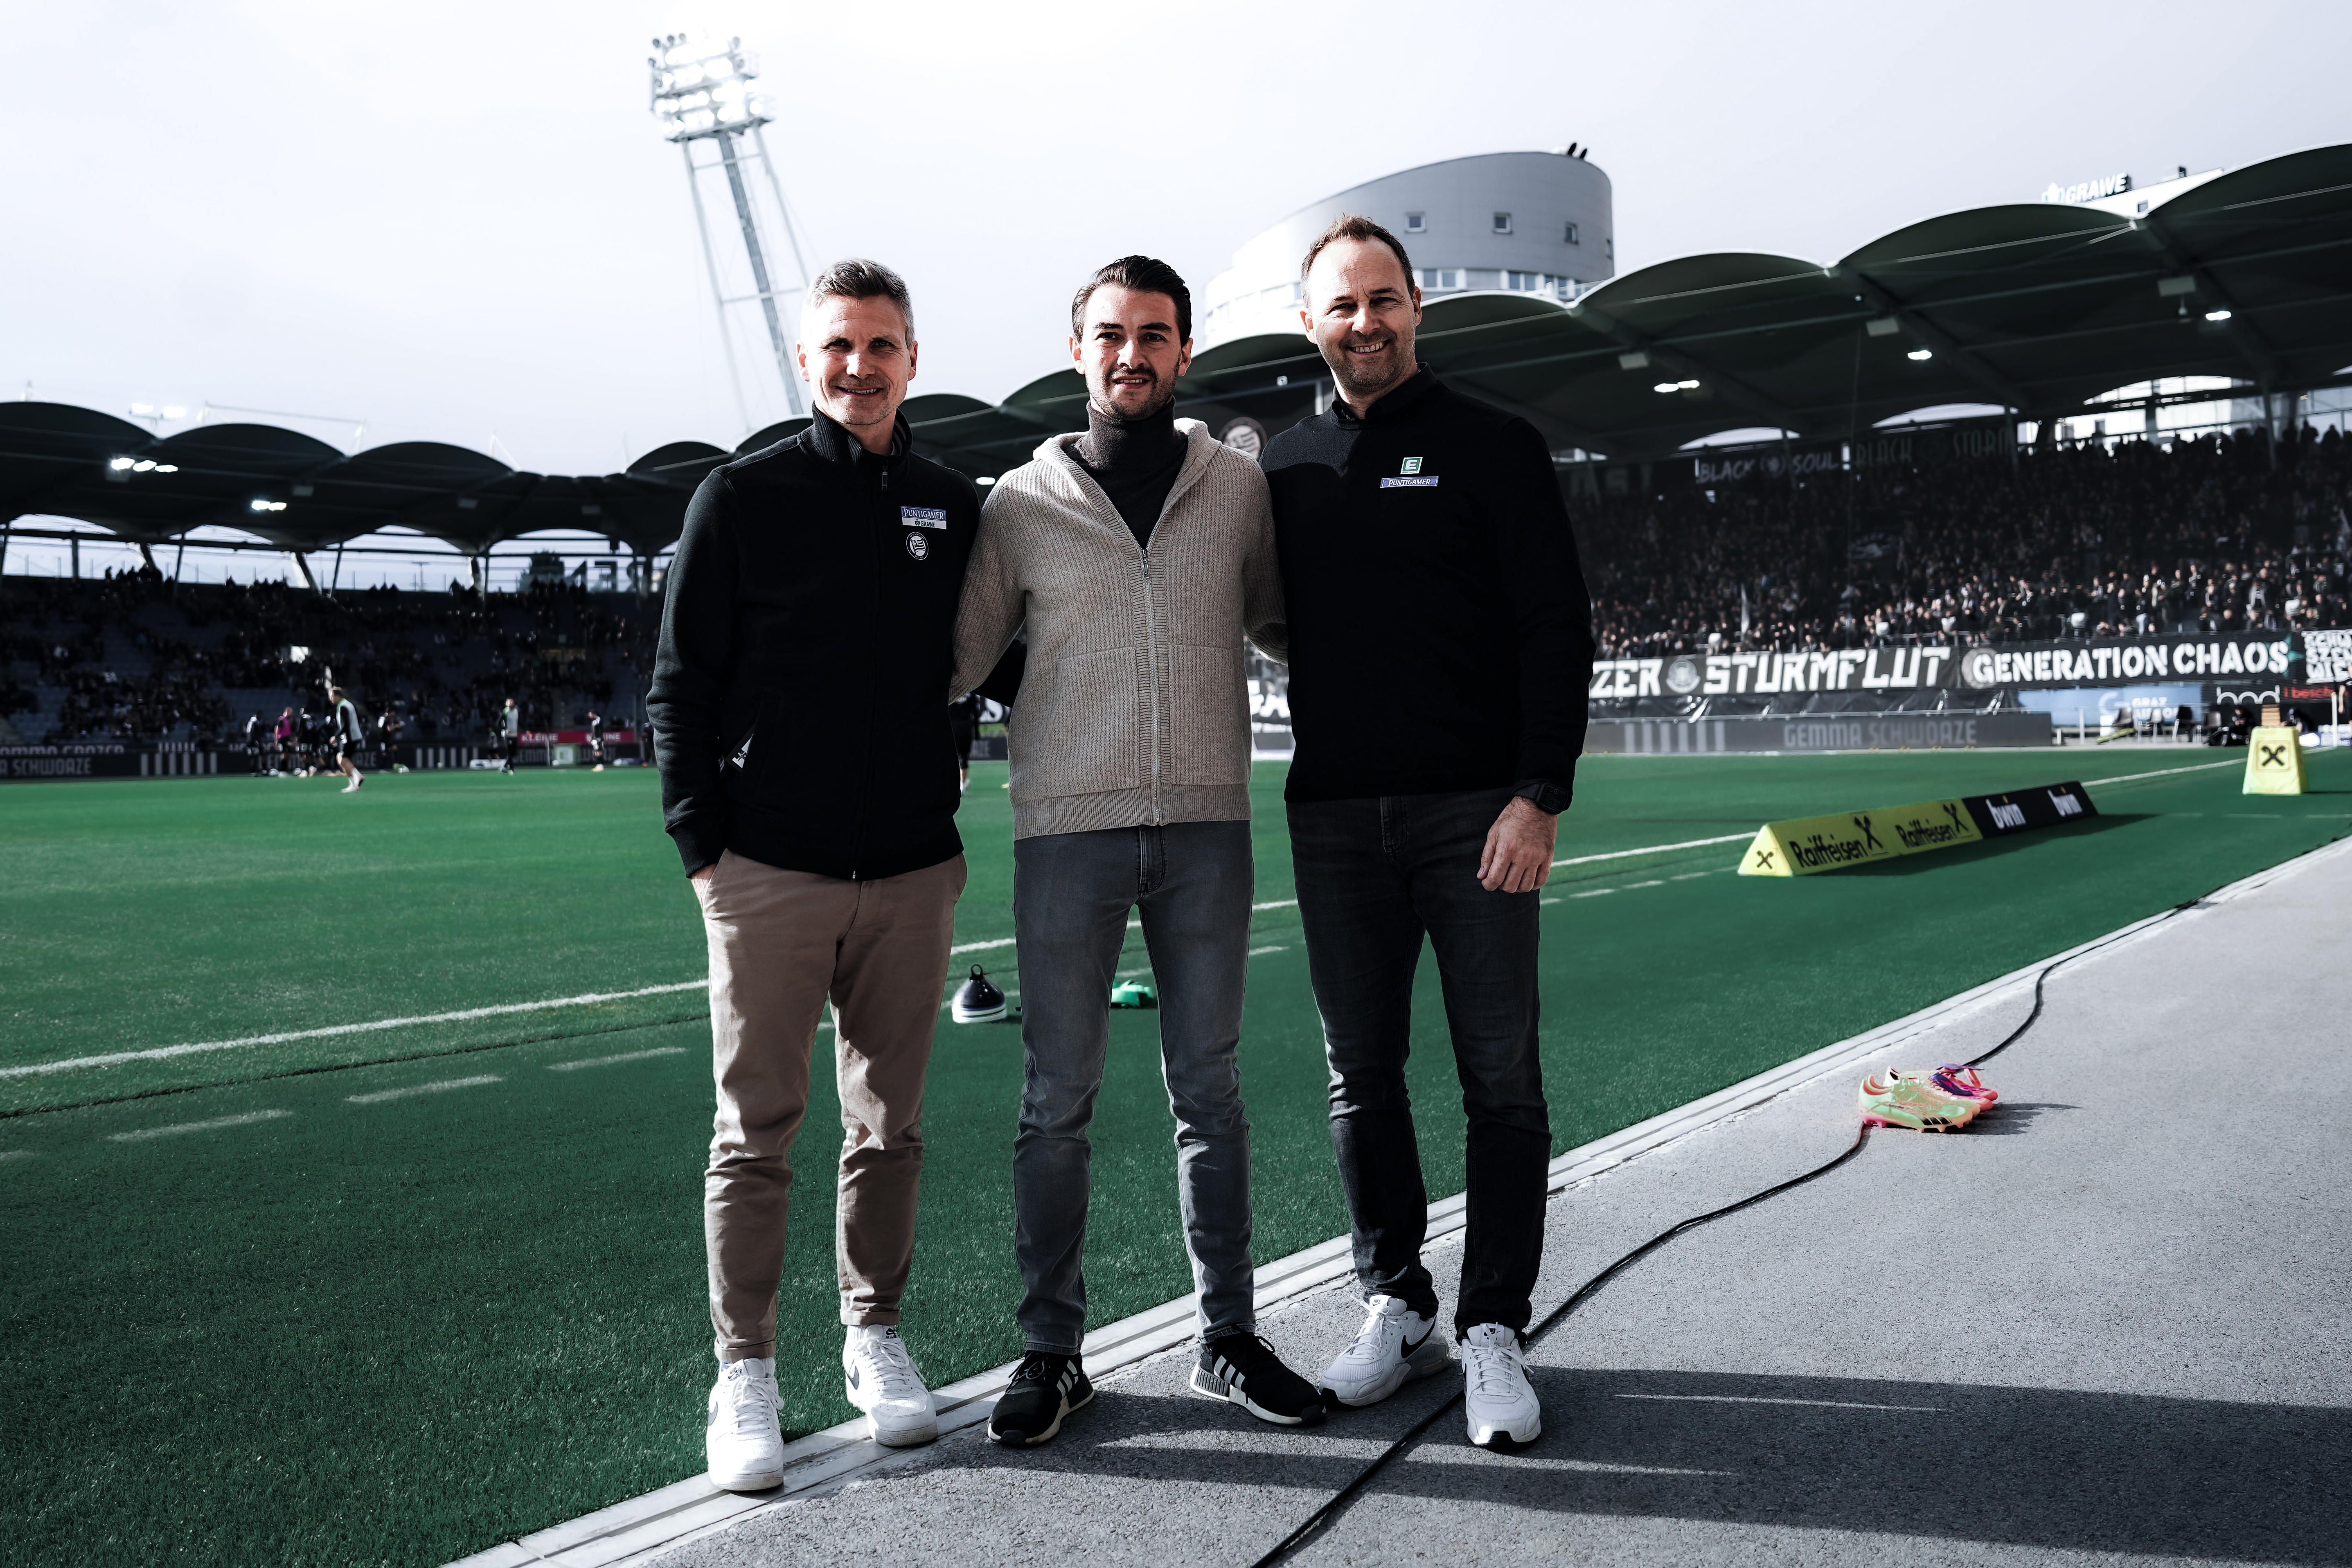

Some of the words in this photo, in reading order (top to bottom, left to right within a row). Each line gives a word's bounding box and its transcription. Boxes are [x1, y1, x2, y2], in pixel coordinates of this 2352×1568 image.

[2066, 172, 2128, 204] GRAWE
[1699, 458, 1755, 484] BLACK
[1792, 452, 1838, 475] SOUL
[903, 509, 944, 520] PUNTIGAMER
[1590, 658, 1664, 698] ZER
[1703, 646, 1951, 694] STURMFLUT
[1973, 644, 2168, 684] GENERATION
[2173, 641, 2289, 674] CHAOS
[1783, 722, 1862, 748] GEMMA
[1986, 795, 2026, 829] bwin
[2047, 786, 2083, 817] bwin
[1895, 819, 1958, 848] Raiffeisen
[1789, 833, 1869, 867] Raiffeisen
